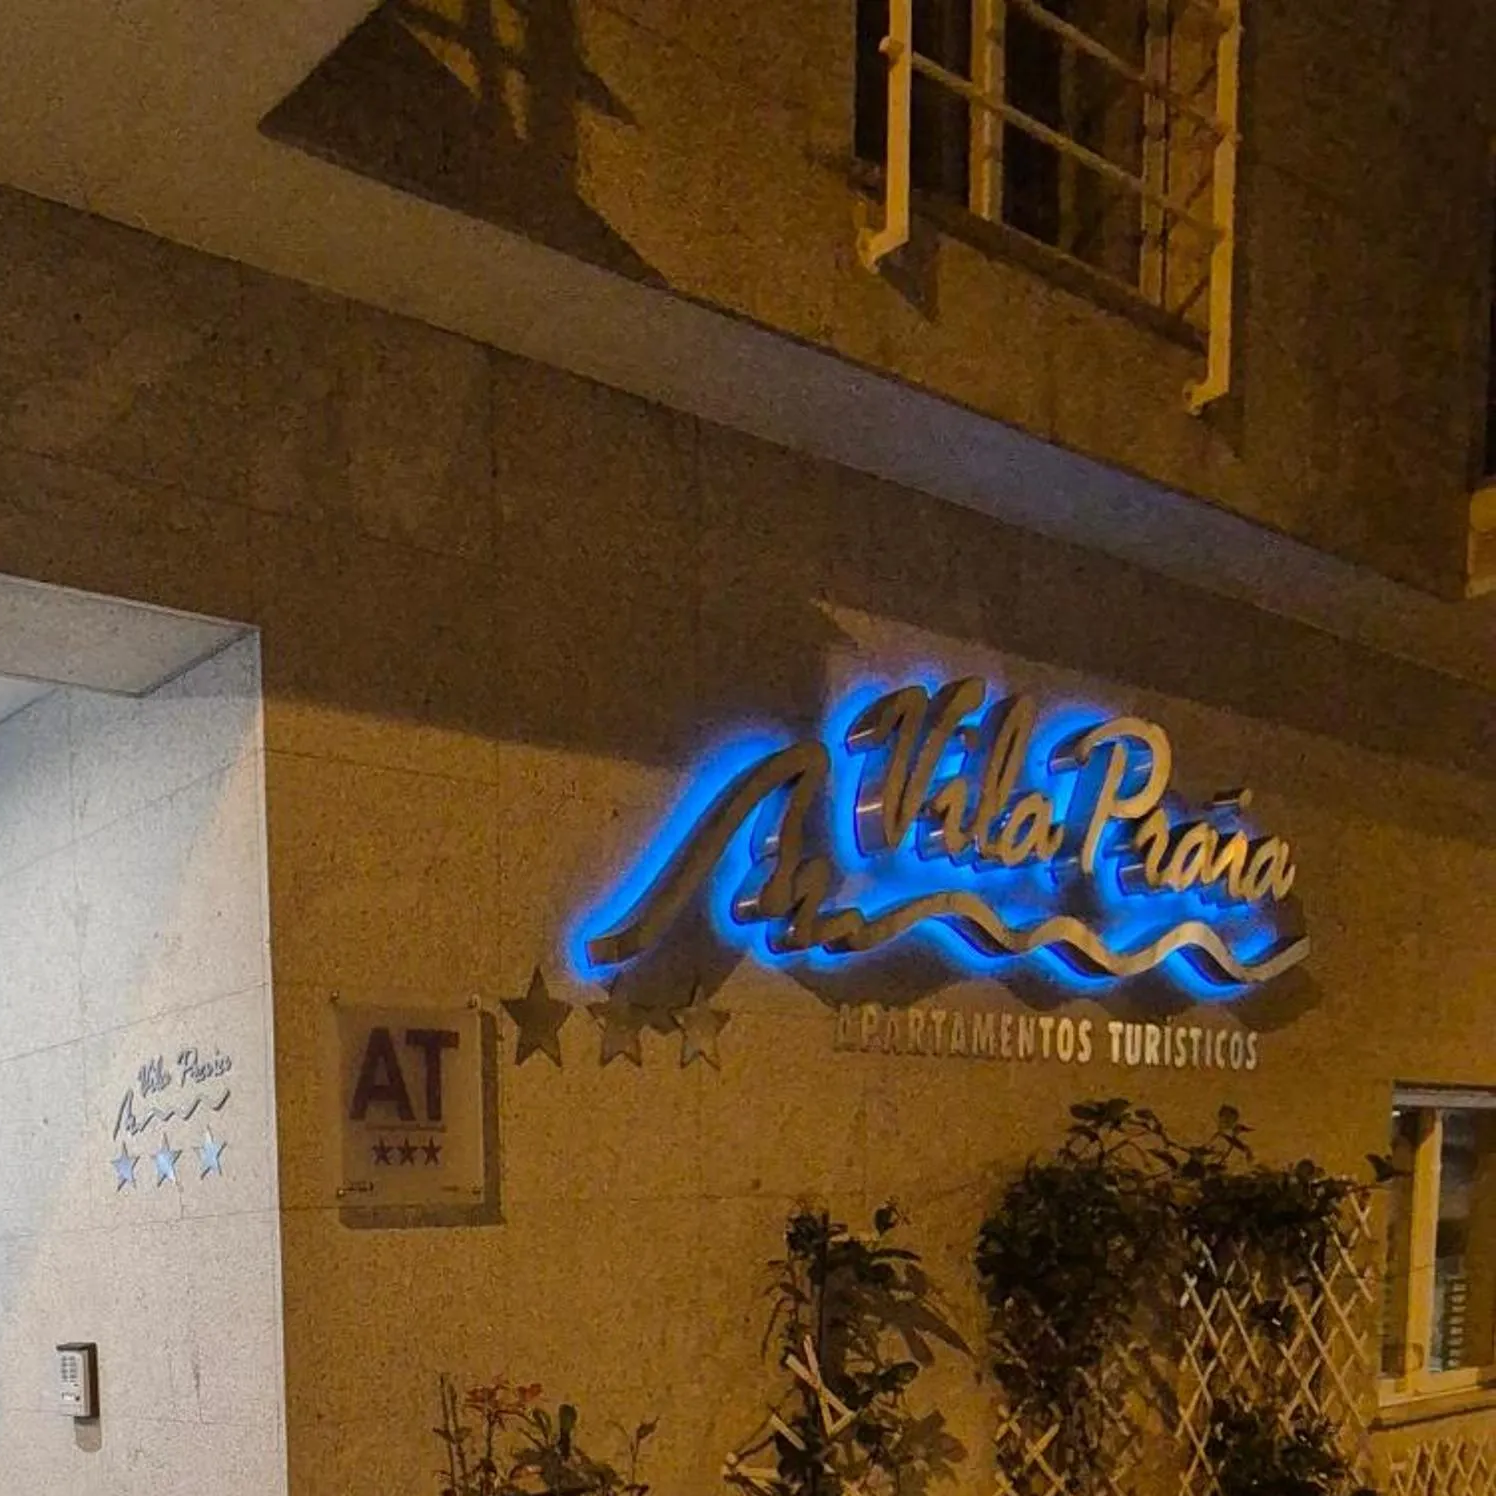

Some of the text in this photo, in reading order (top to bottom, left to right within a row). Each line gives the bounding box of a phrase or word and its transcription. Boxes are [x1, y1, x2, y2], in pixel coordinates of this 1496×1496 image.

[849, 676, 1296, 900] Vila Praia
[349, 1027, 460, 1122] AT
[834, 1001, 1257, 1070] APARTAMENTOS TURÍSTICOS
